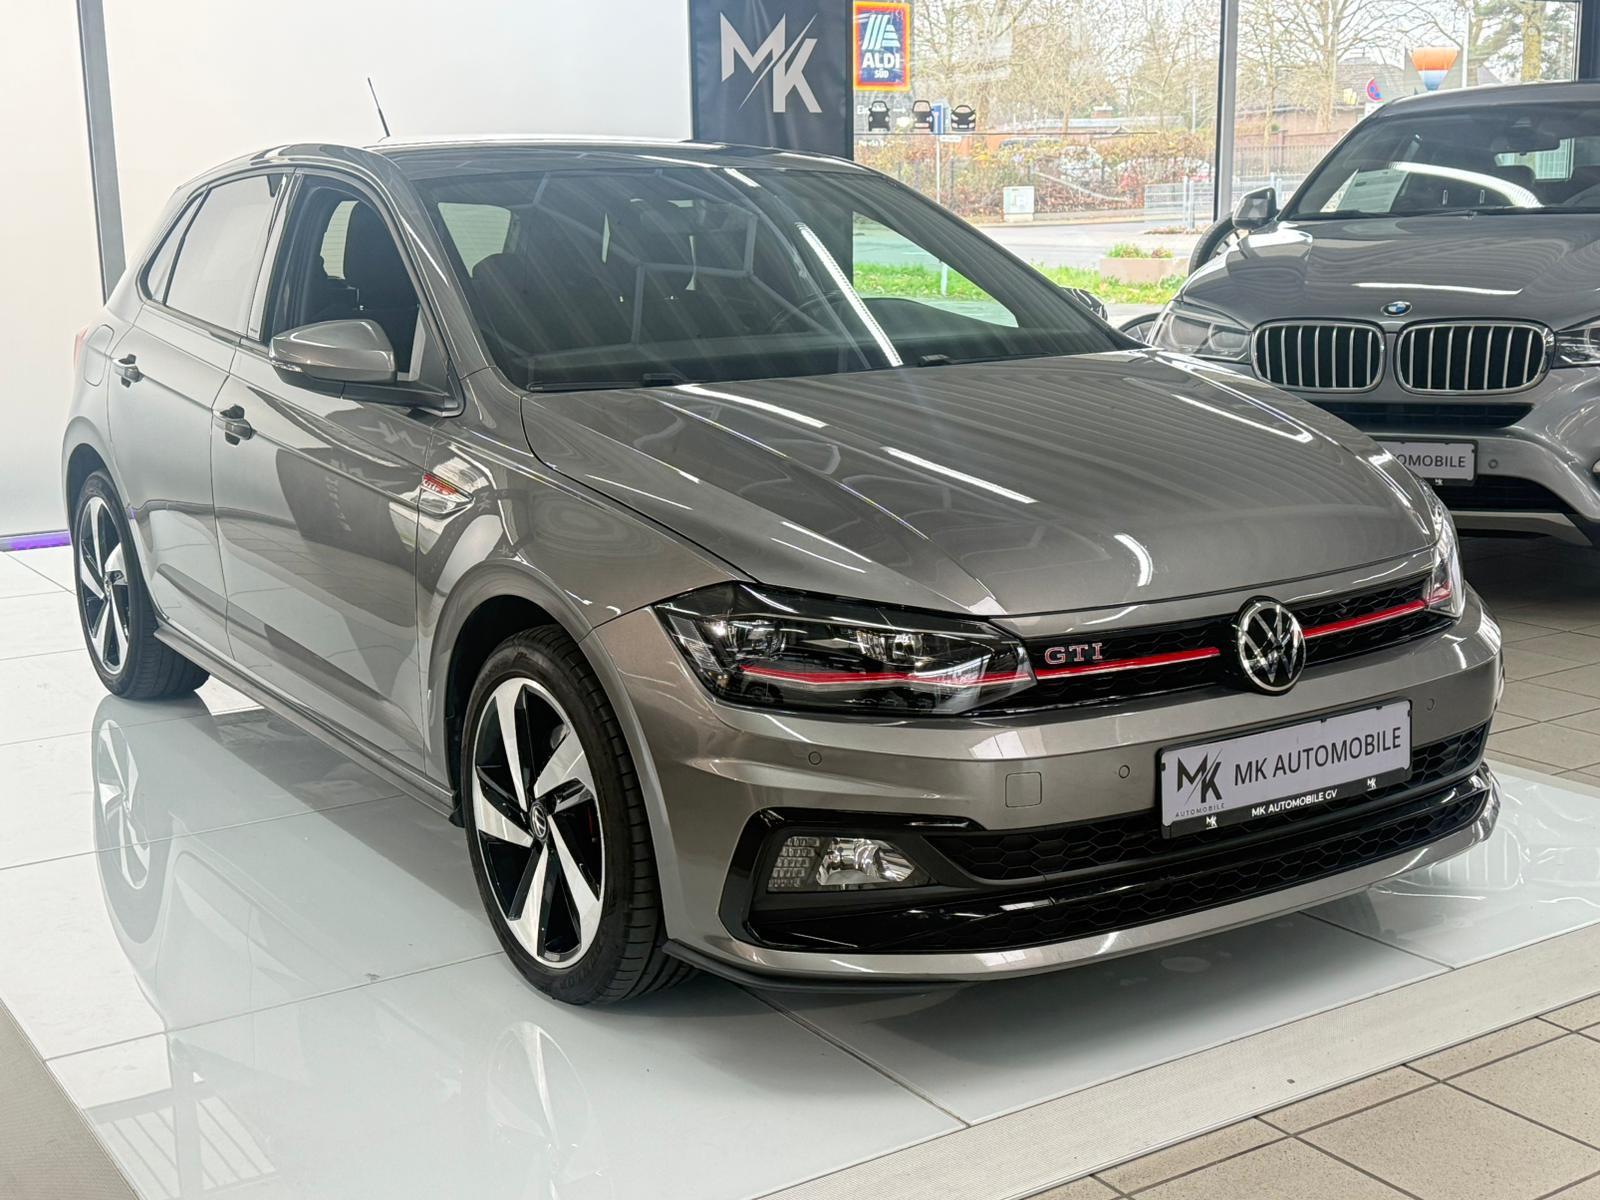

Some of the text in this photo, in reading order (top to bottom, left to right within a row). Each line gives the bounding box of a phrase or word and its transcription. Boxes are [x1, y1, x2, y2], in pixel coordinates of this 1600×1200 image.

[862, 52, 900, 69] ALDI
[873, 69, 890, 79] SÜD
[1394, 454, 1466, 468] OMOBILE
[1044, 642, 1104, 665] GTI
[1234, 726, 1402, 786] MK AUTOMOBILE
[1175, 802, 1225, 818] AUTOMOBILE
[1251, 805, 1267, 817] MK
[1267, 792, 1324, 814] AUTOMOBILE
